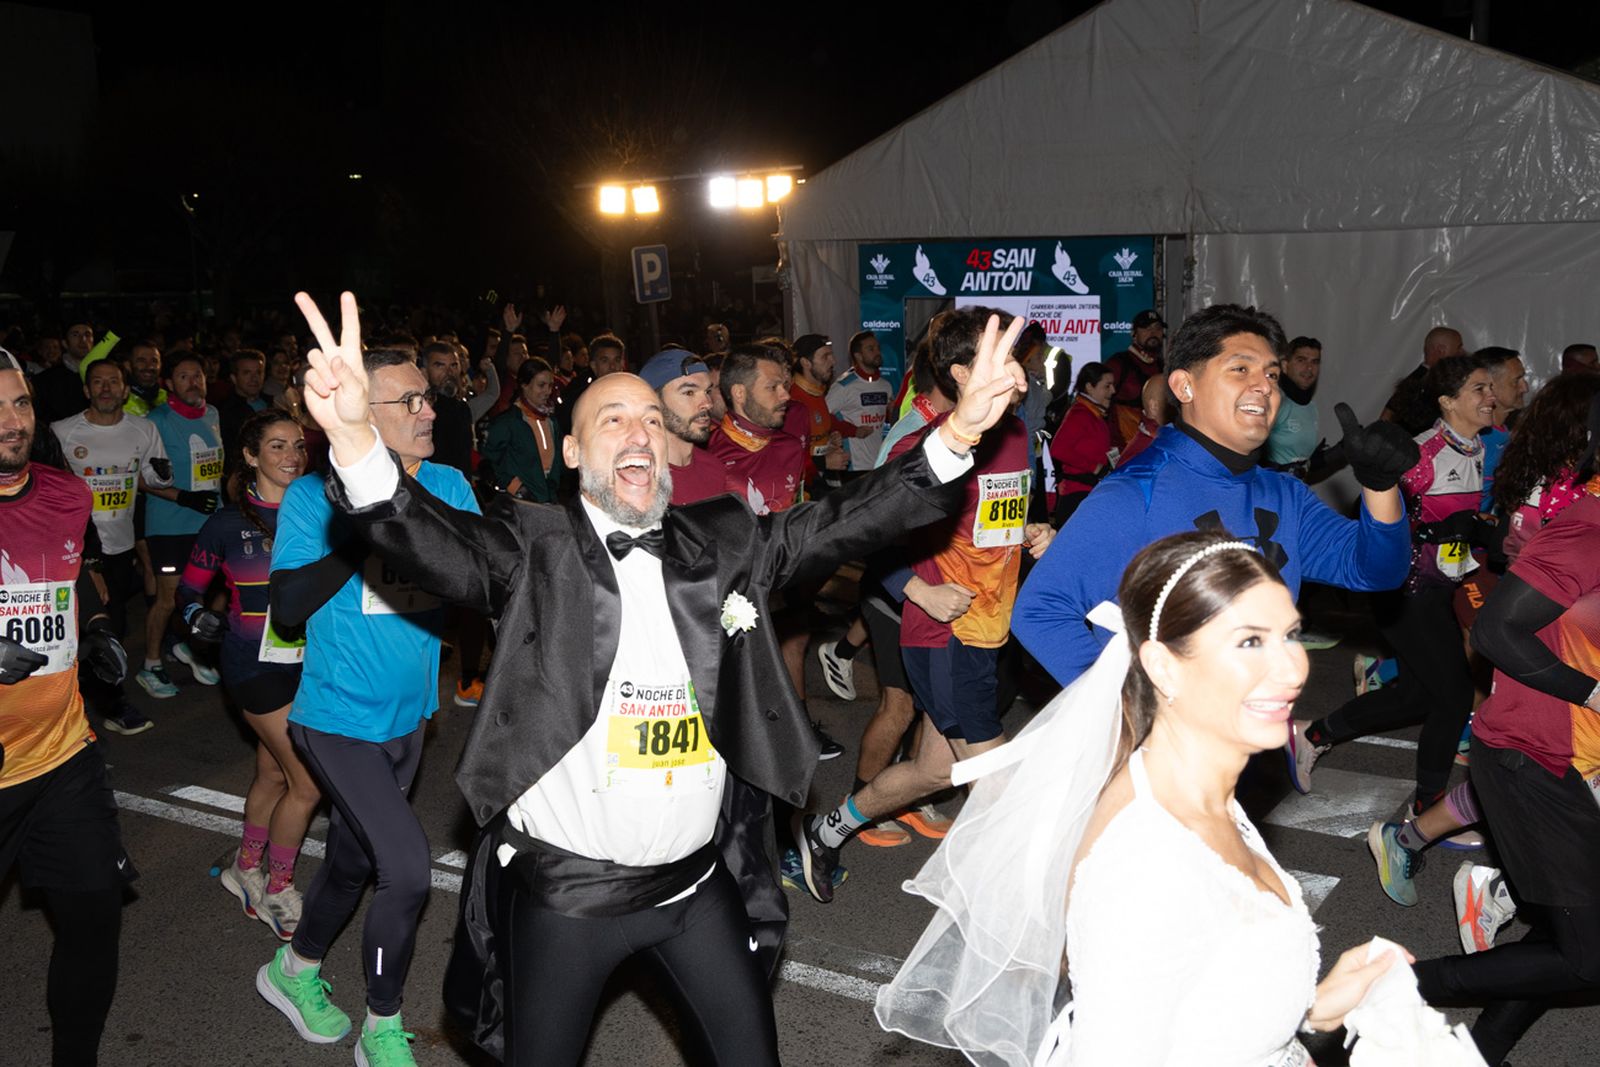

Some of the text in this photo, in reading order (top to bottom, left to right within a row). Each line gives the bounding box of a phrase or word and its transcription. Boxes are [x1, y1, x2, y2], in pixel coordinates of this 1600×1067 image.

[641, 253, 662, 295] P
[923, 273, 936, 287] 43
[960, 266, 1032, 291] ANTÓN
[1062, 271, 1077, 286] 43
[99, 491, 127, 506] 1732
[989, 498, 1024, 522] 8189
[11, 593, 41, 603] NOCHE
[1463, 582, 1485, 609] FILA
[0, 606, 19, 616] SAN
[7, 614, 65, 645] 6088
[636, 688, 673, 701] NOCHE
[620, 702, 646, 717] SAN
[634, 717, 699, 756] 1847
